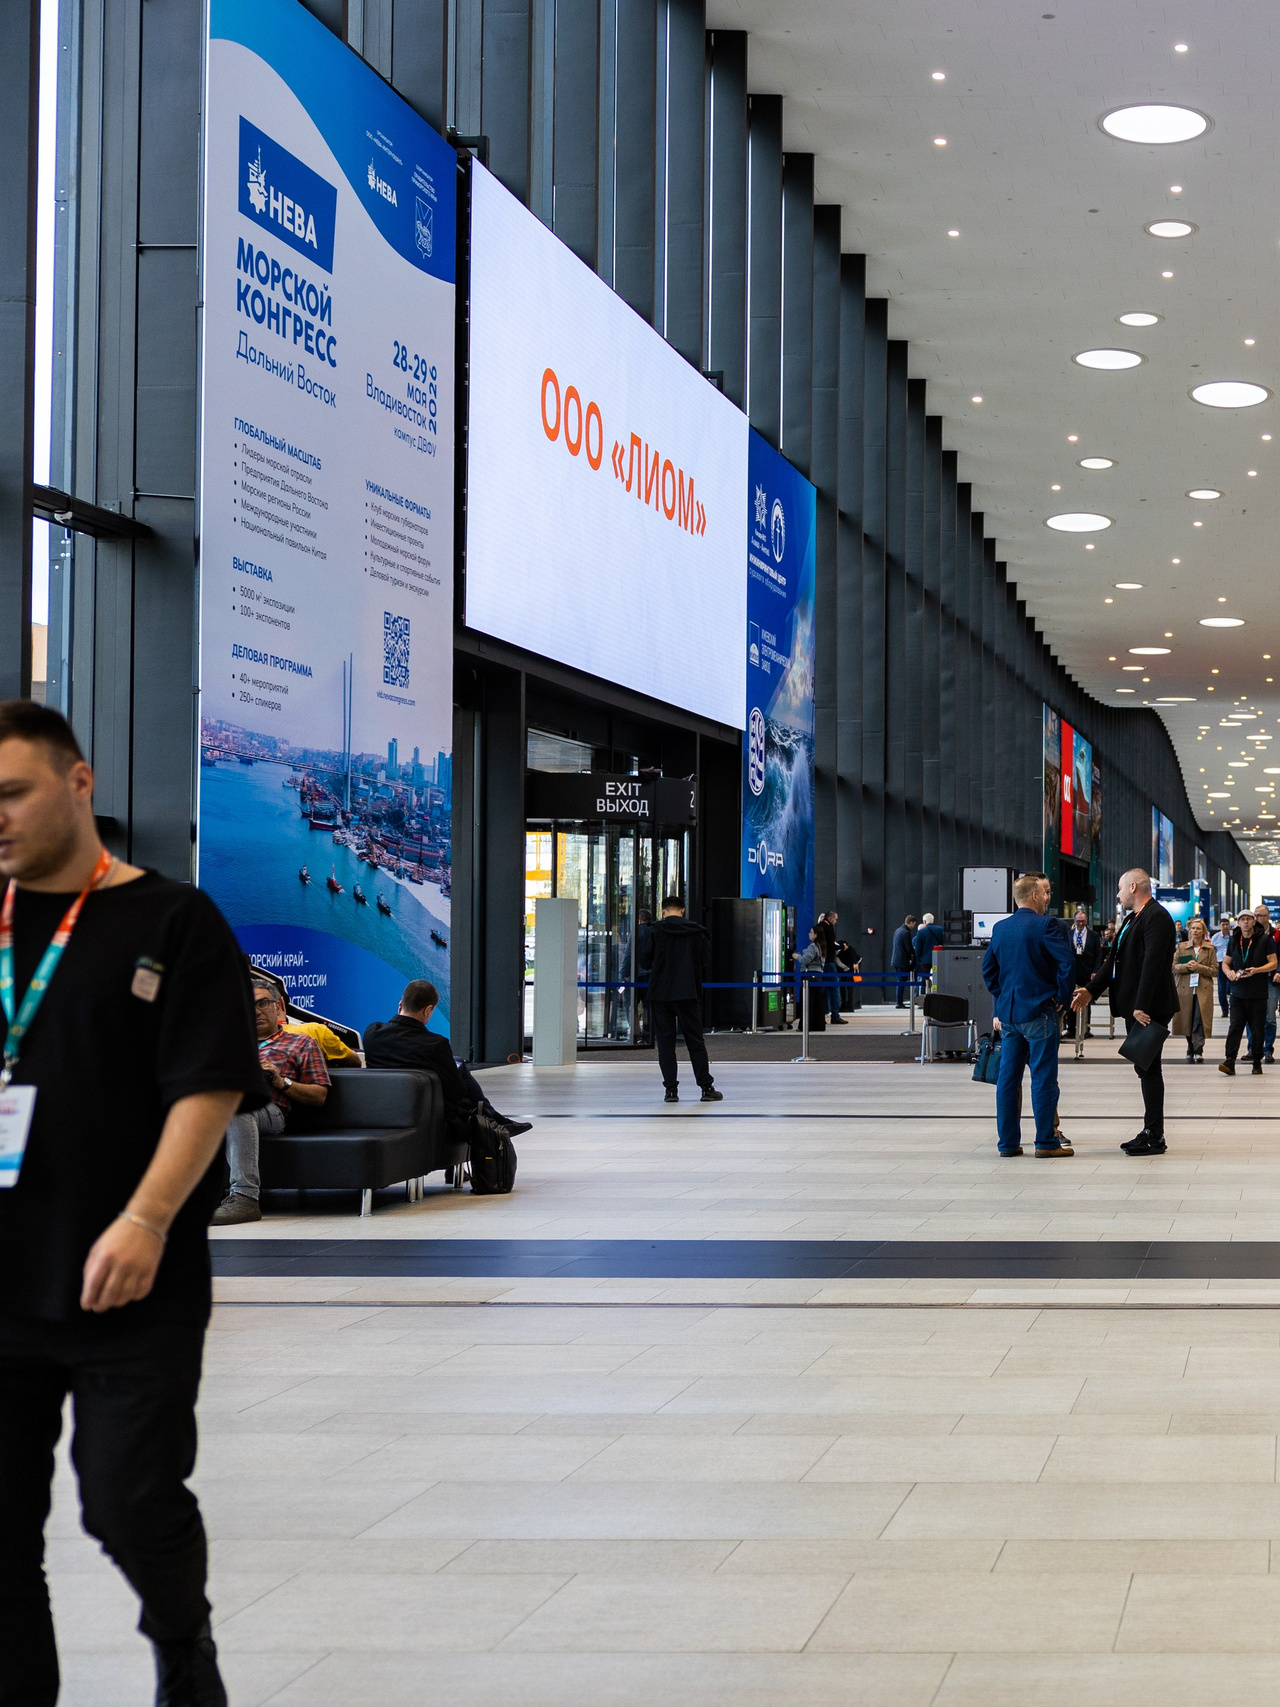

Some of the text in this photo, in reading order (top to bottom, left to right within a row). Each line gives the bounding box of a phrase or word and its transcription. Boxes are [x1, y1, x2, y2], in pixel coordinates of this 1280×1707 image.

[376, 176, 398, 208] НЕВА
[269, 186, 318, 250] НЕВА
[237, 237, 332, 327] МОРСКОЙ
[236, 279, 337, 368] КОНГРЕСС
[236, 330, 336, 408] Дальний Восток
[392, 340, 428, 383] 28-29
[366, 372, 427, 430] Владивосток
[406, 382, 427, 409] мая
[428, 365, 437, 436] 2026
[234, 417, 322, 470] ГЛОБАЛЬНЫЙ МАСШТАБ
[394, 427, 437, 457] кампус ДВФУ
[541, 368, 707, 538] ООО «ЛИОМ»
[241, 443, 312, 485] Лидеры морской отрасли
[241, 461, 328, 510] Предприятия Дальнего Востока
[241, 479, 311, 520] Морские регионы России
[365, 479, 431, 520] УНИКАЛЬНЫЕ ФОРМАТЫ
[241, 498, 318, 539] Международные участники
[240, 516, 327, 560] Национальный павильон Китая
[232, 557, 273, 583] ВЫСТАВКА
[240, 585, 254, 601] 5000
[263, 596, 295, 614] экспозиции
[240, 604, 291, 631] 100+ экспонентов
[231, 643, 313, 678] ДЕЛОВАЯ ПРОГРАММА
[239, 673, 289, 695] 40+ мероприятий
[239, 691, 281, 712] 250+ спикеров
[596, 799, 649, 816] ВЫХОД
[605, 782, 642, 796] EXIT
[690, 791, 695, 808] 2
[249, 951, 303, 967] ОРСКИЙ КРАЙ
[281, 974, 327, 988] ОТА РОССИИ
[290, 995, 314, 1008] СТОКЕ
